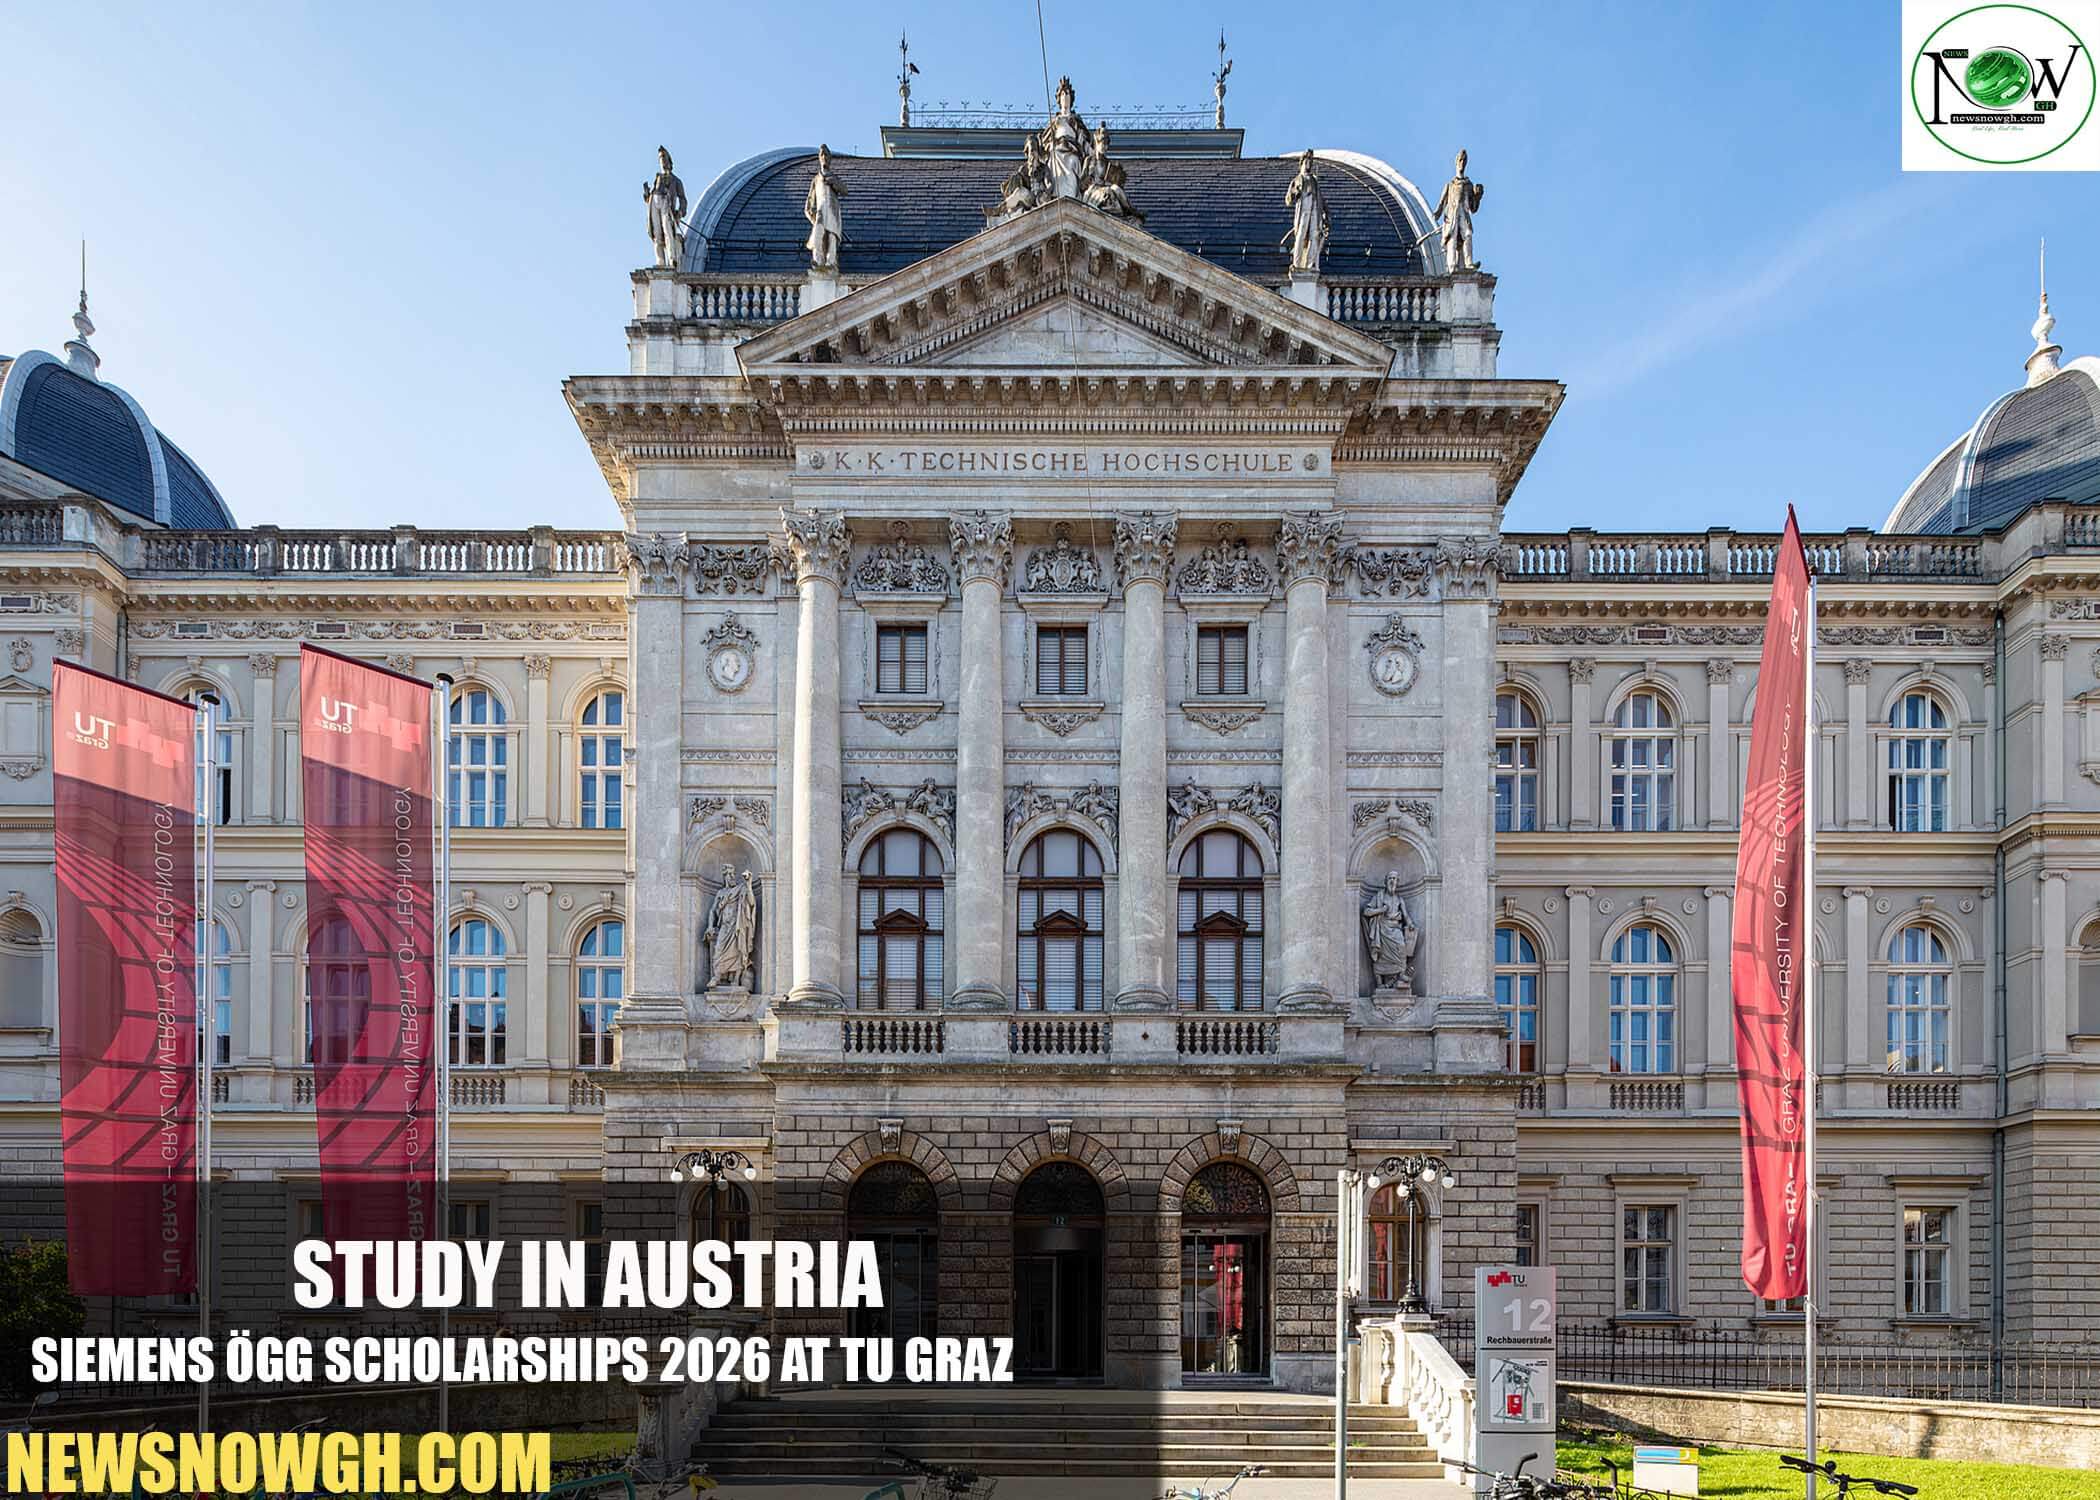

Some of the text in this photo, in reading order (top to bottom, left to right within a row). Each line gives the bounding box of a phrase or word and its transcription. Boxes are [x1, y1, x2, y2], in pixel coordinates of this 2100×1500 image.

[1103, 454, 1293, 472] HOCHSCHULE
[1773, 875, 1788, 908] OF
[1512, 1274, 1526, 1284] TU
[1503, 1298, 1552, 1332] 12
[1486, 1336, 1553, 1345] Rechbauerstraße
